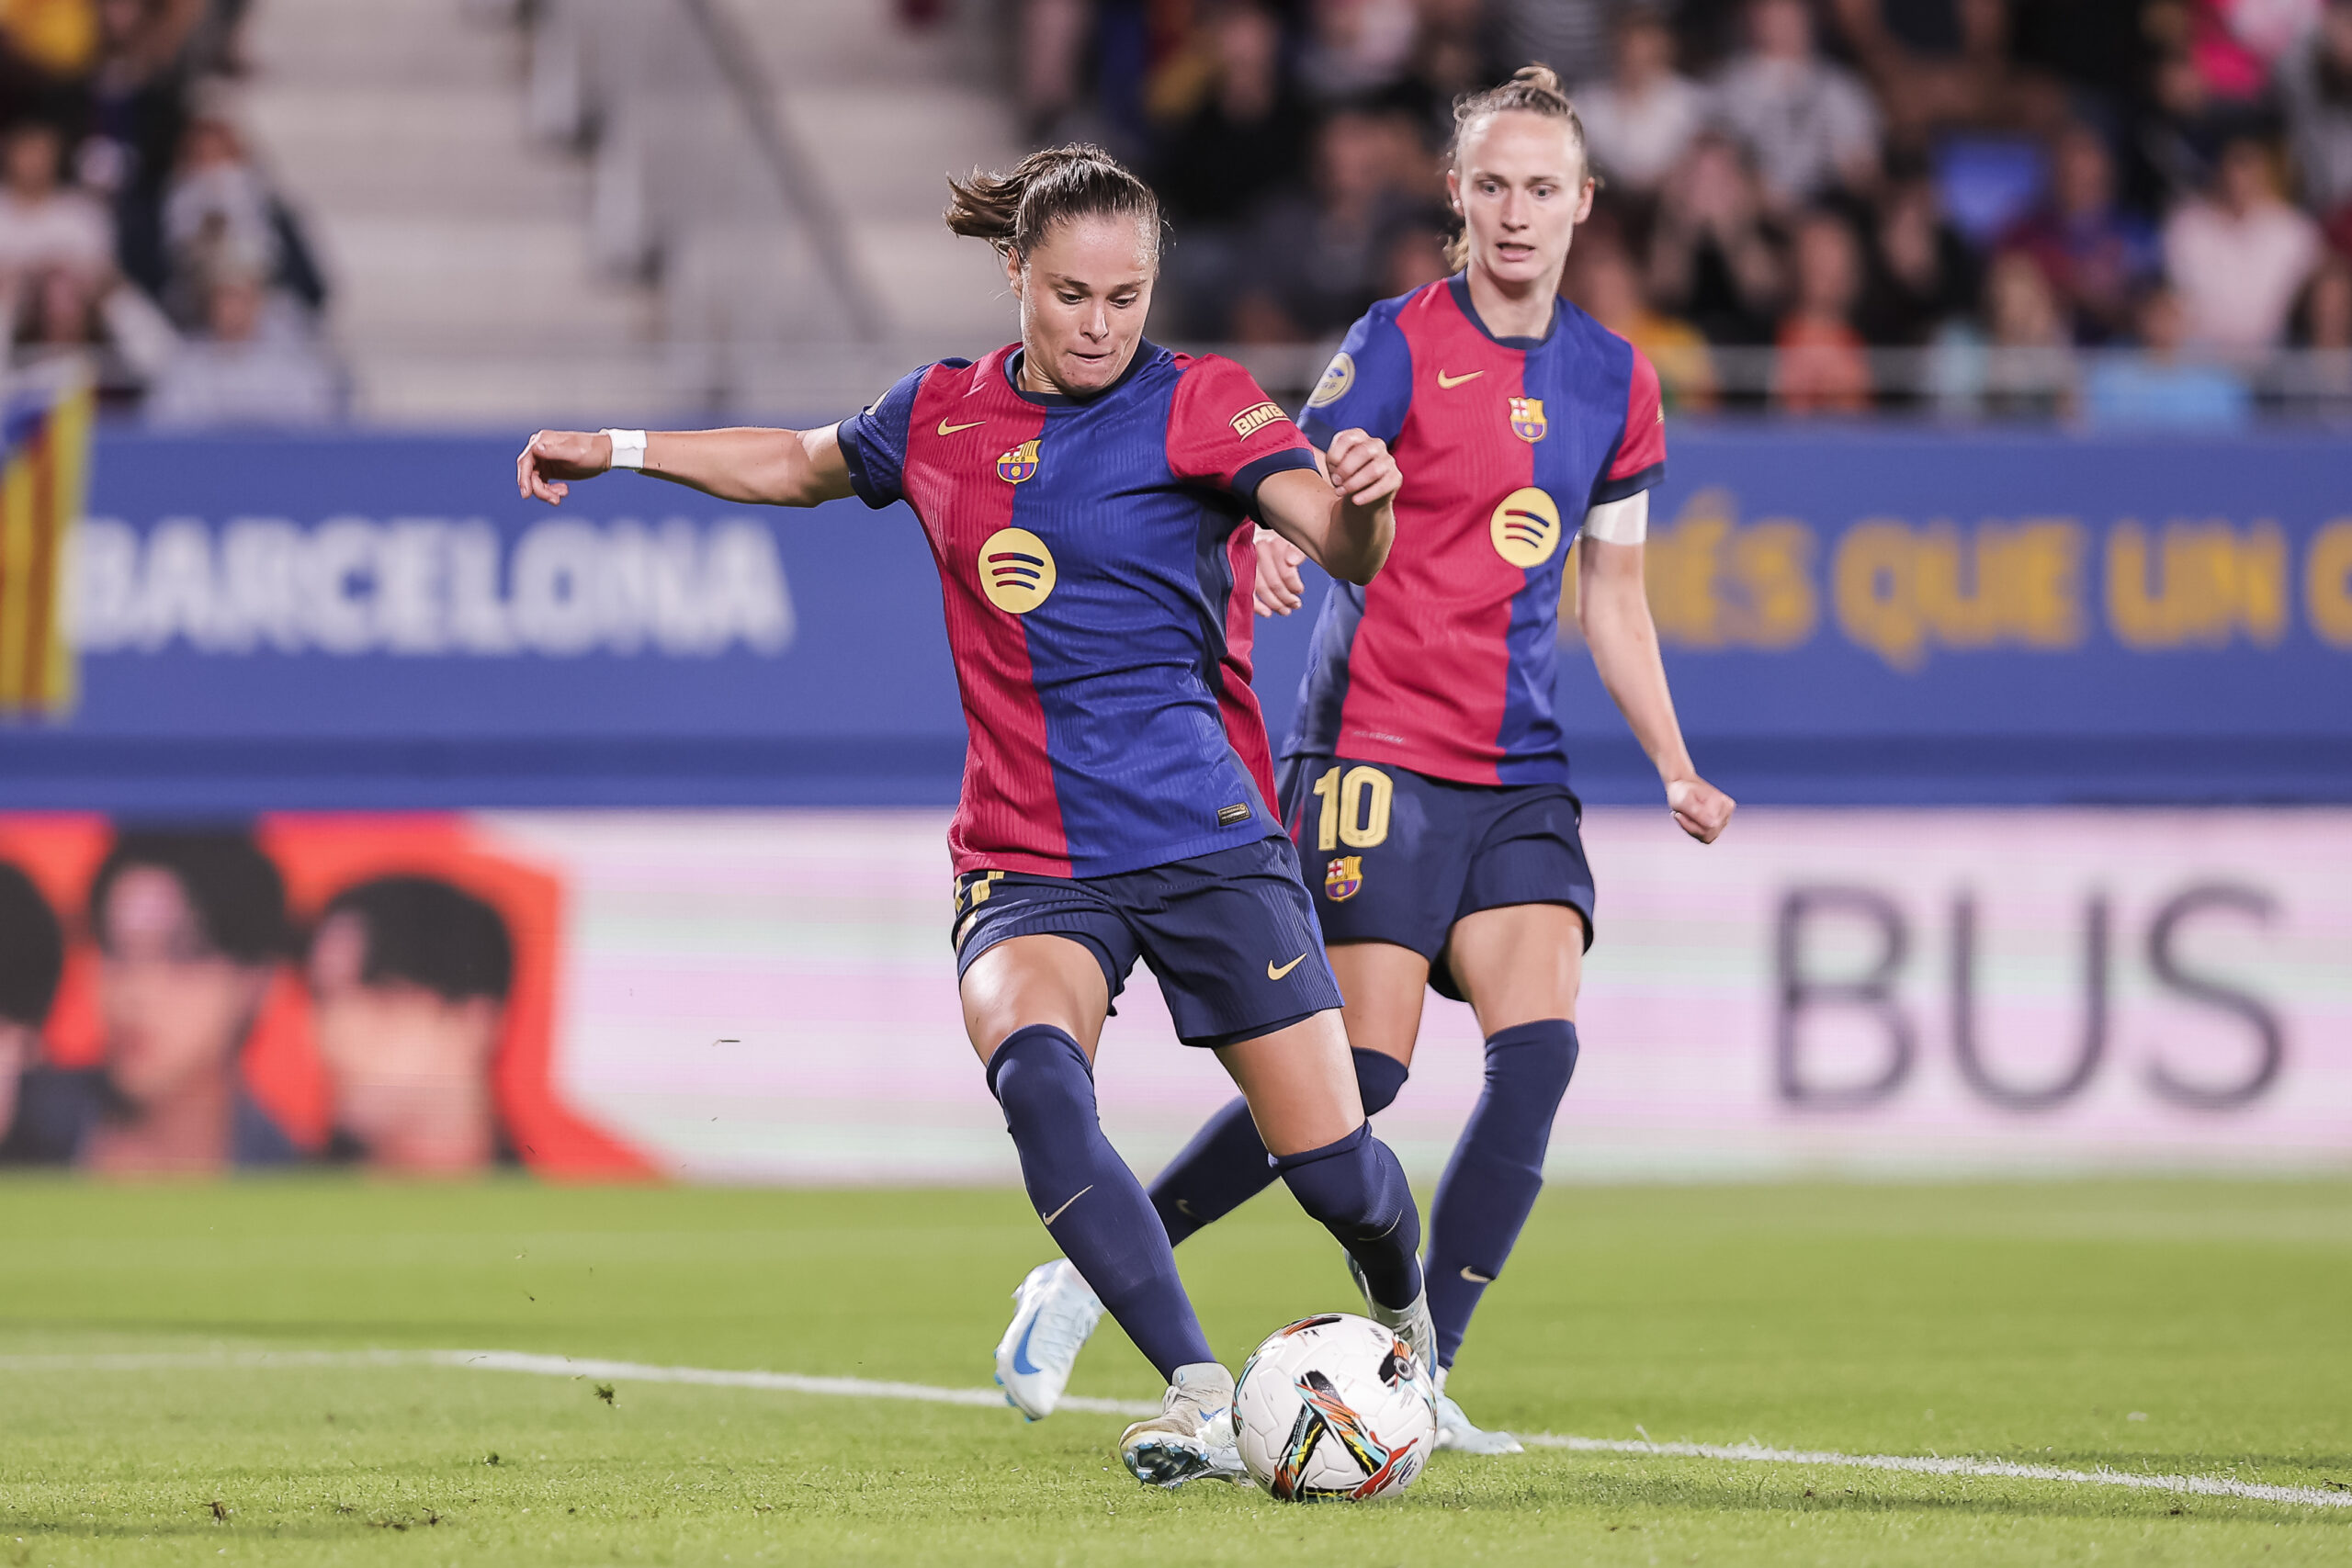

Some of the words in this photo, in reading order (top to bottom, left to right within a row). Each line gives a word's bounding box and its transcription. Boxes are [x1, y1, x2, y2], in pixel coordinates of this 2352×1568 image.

[1232, 404, 1287, 435] BIMB
[61, 517, 794, 656] BARCELONA
[1835, 521, 2083, 671] QUE
[2107, 521, 2288, 650] UN
[1313, 765, 1394, 851] 10
[1778, 884, 2283, 1113] BUS
